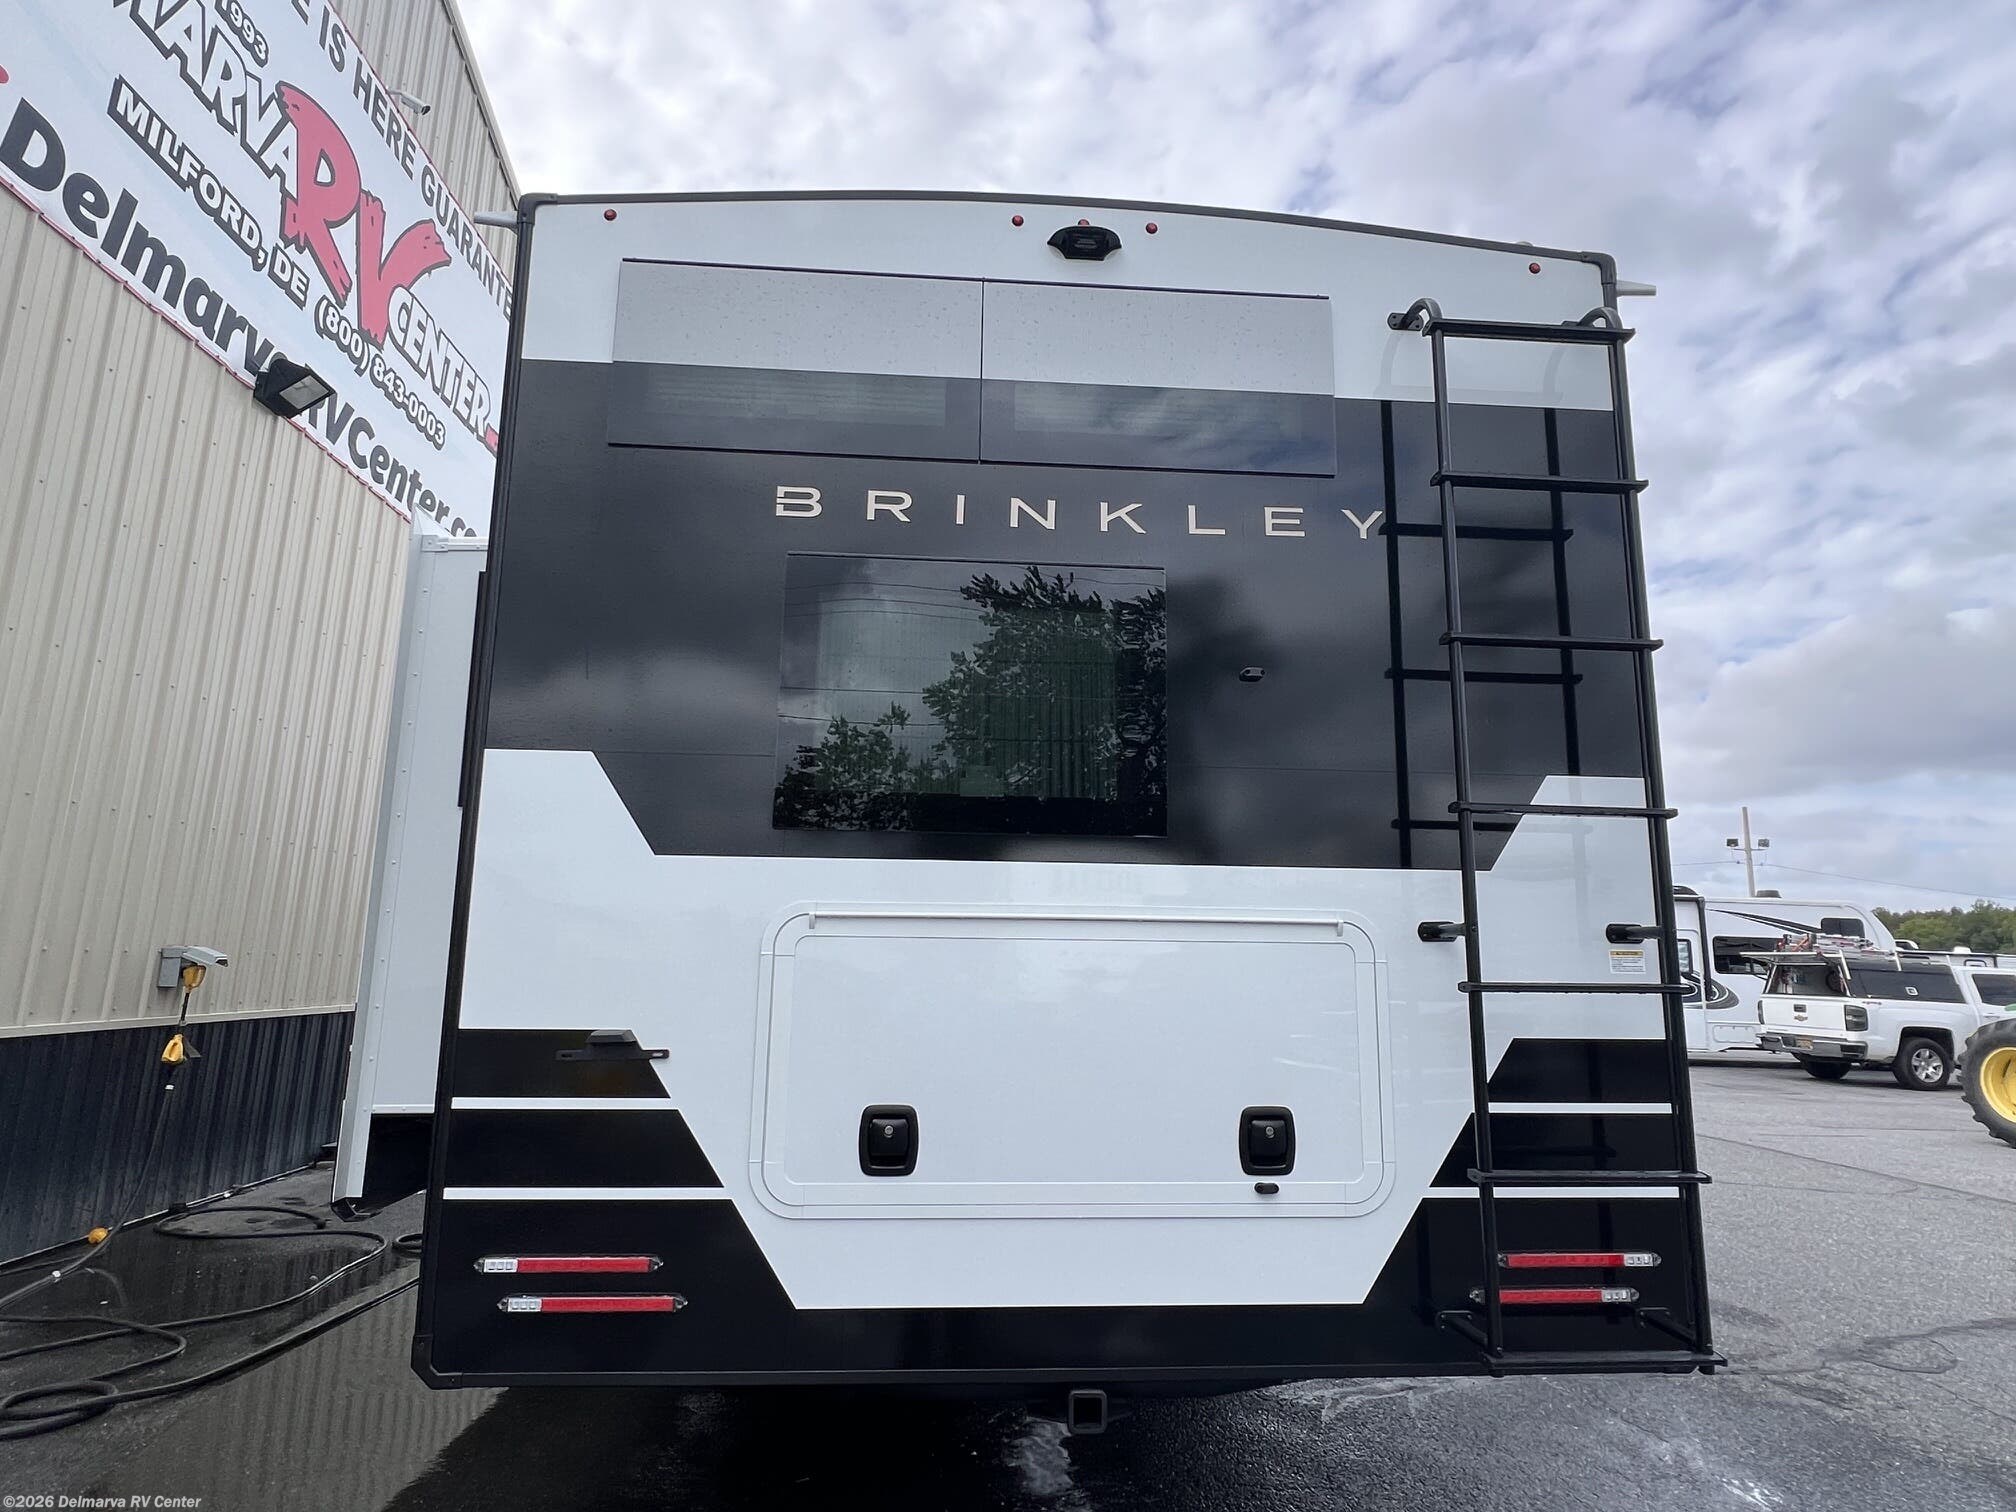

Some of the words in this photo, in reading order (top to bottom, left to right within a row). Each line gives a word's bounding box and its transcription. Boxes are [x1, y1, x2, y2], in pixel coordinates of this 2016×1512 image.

[319, 5, 346, 72] IS
[353, 56, 416, 180] HERE
[110, 76, 268, 270] MILFORD,
[269, 243, 310, 309] DE
[315, 295, 371, 376] (800)
[370, 353, 446, 450] 843-0003
[776, 485, 1384, 540] BRINKLEY
